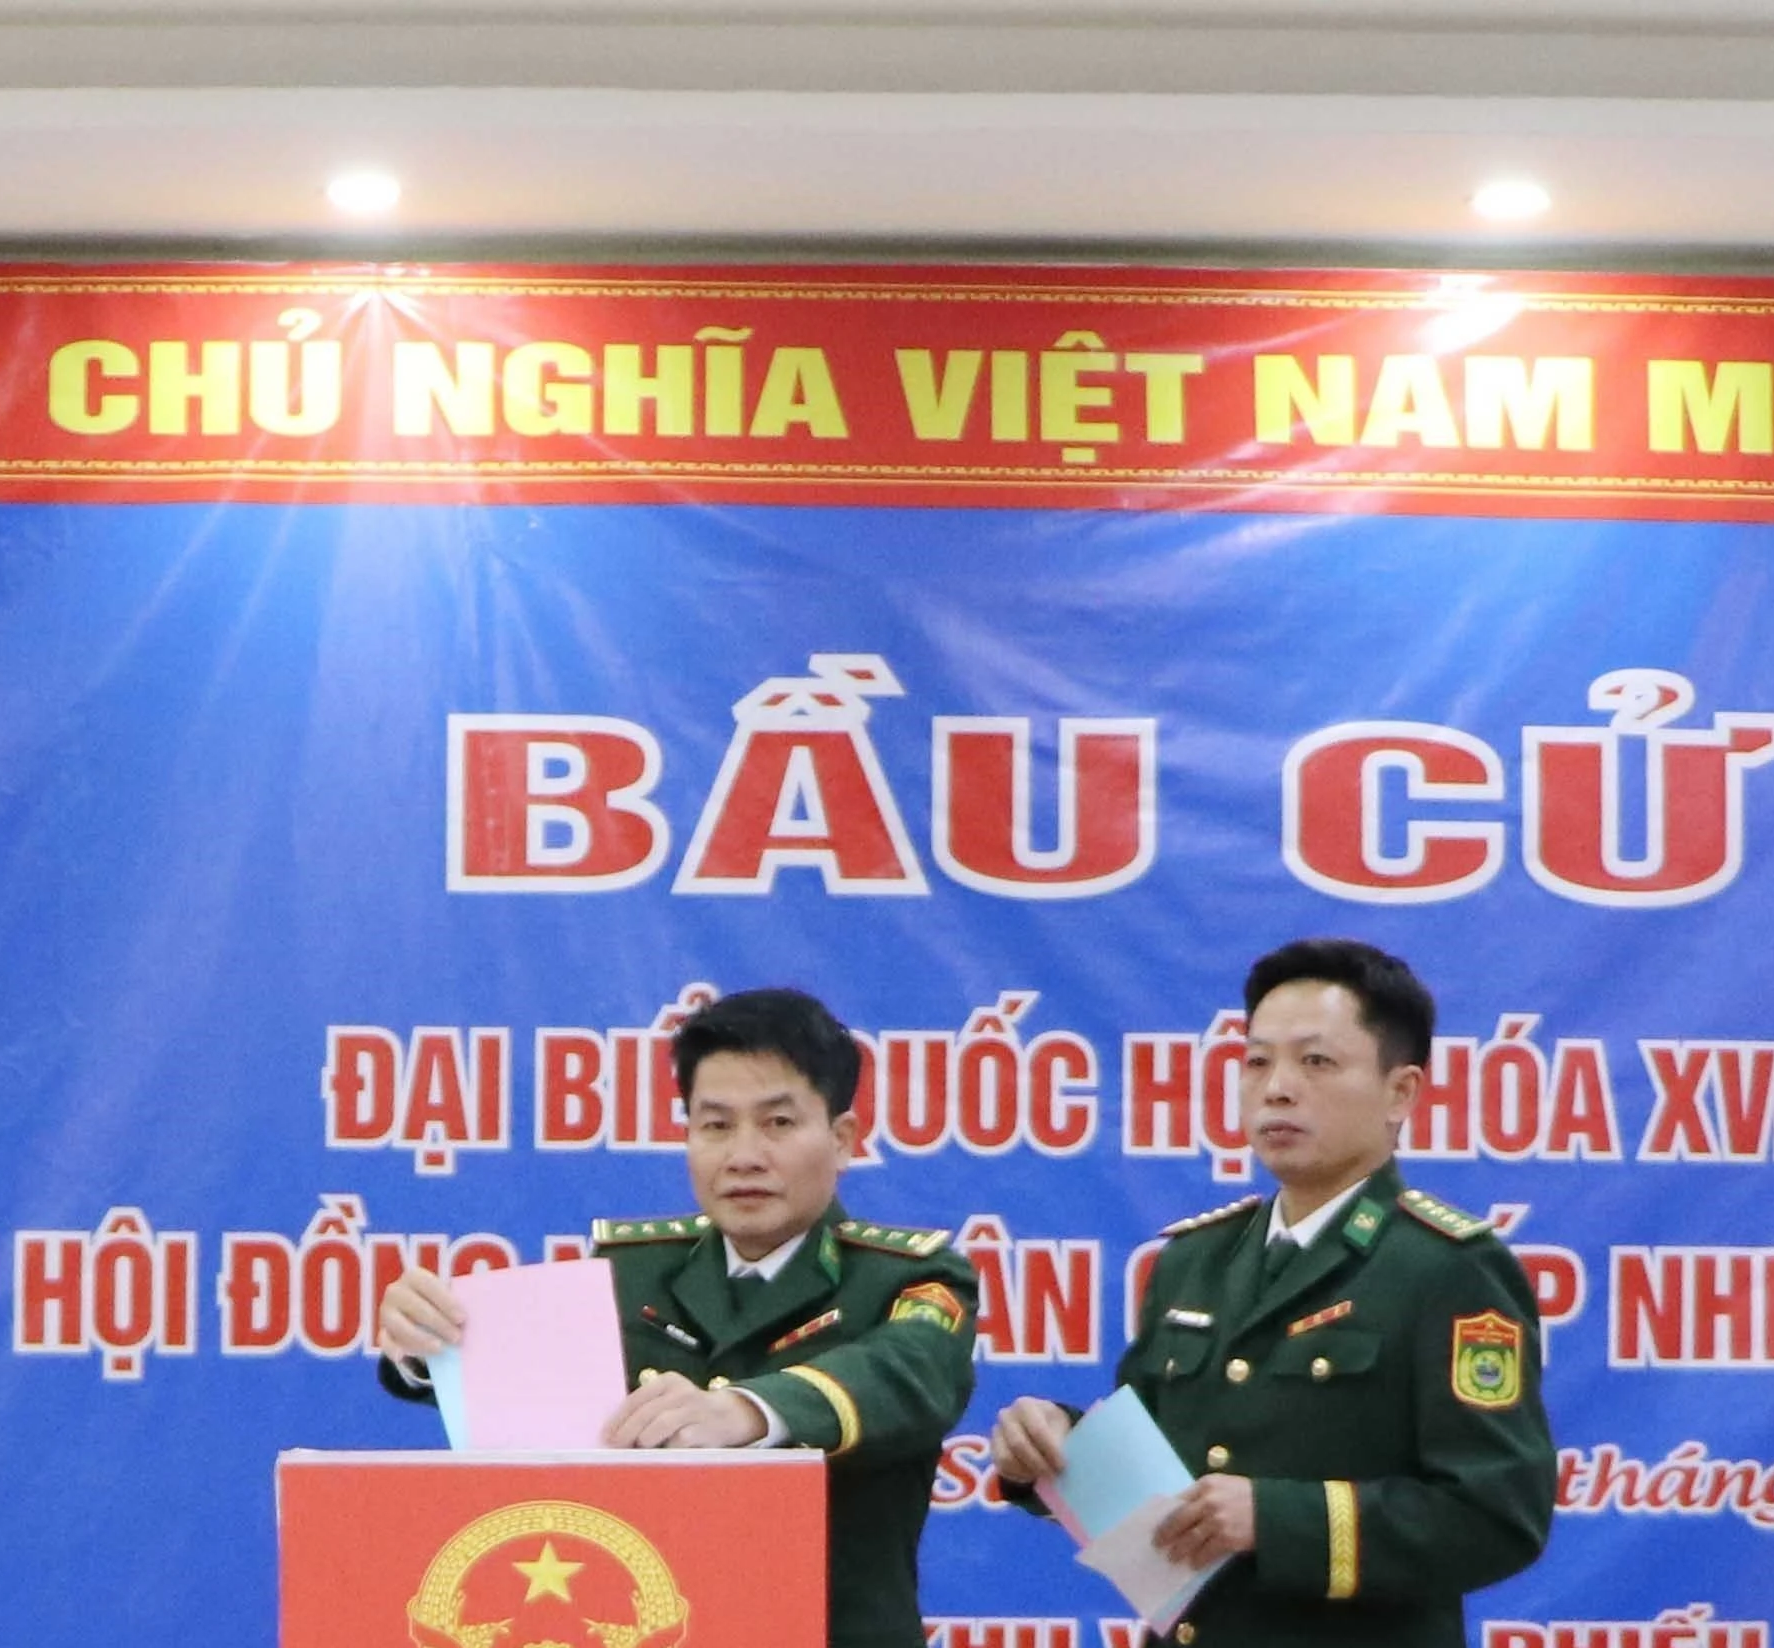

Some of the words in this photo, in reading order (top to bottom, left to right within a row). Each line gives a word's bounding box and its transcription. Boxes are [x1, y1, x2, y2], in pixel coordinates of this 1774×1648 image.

[47, 307, 344, 436] CHỦ
[393, 326, 849, 438] NGHĨA
[898, 332, 1204, 464] VIỆT
[1254, 353, 1598, 450] NAM
[321, 1025, 511, 1175] ĐẠI
[535, 983, 715, 1154] BIỂ
[1122, 1009, 1253, 1182] HỘ
[1394, 1013, 1622, 1161] HÓA
[13, 1207, 197, 1380] HỘI
